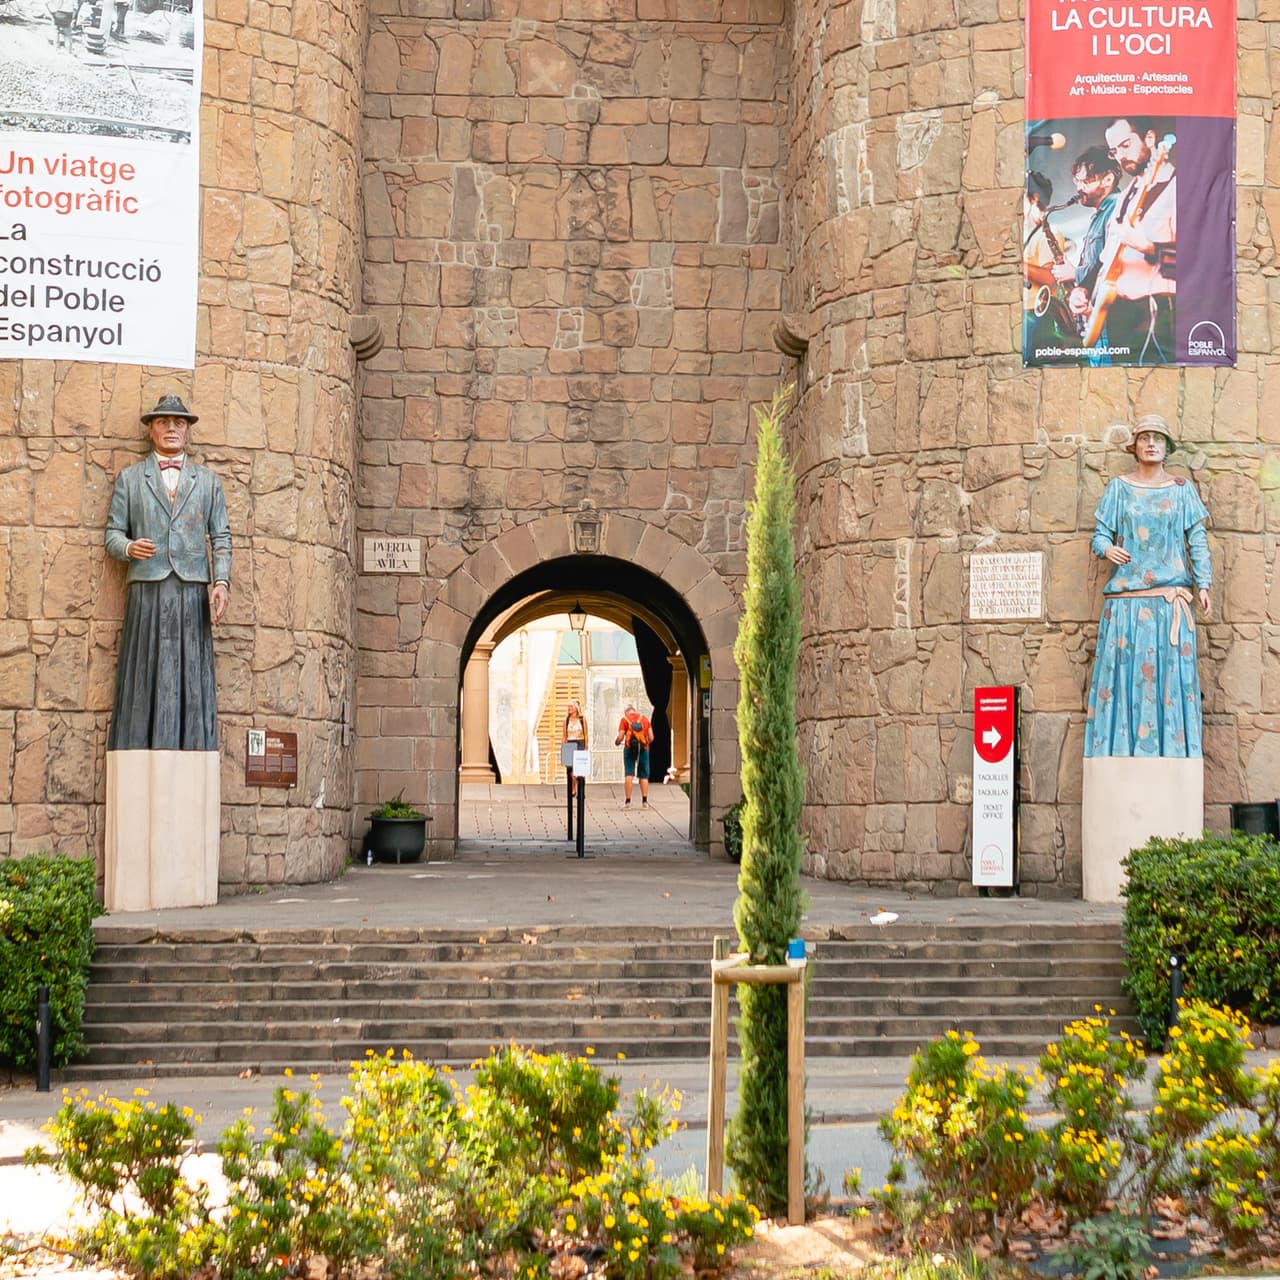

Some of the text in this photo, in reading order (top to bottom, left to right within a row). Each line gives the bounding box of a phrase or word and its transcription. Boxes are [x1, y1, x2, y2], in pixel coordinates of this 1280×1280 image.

[1051, 6, 1213, 31] LA CULTURA
[1092, 33, 1171, 56] I L'OCI
[1069, 84, 1193, 96] Art Música Espectacles
[1074, 72, 1135, 85] Arquitectura
[44, 153, 136, 185] viatge
[45, 285, 125, 313] Poble
[1035, 346, 1130, 358] poble-espanyol.com
